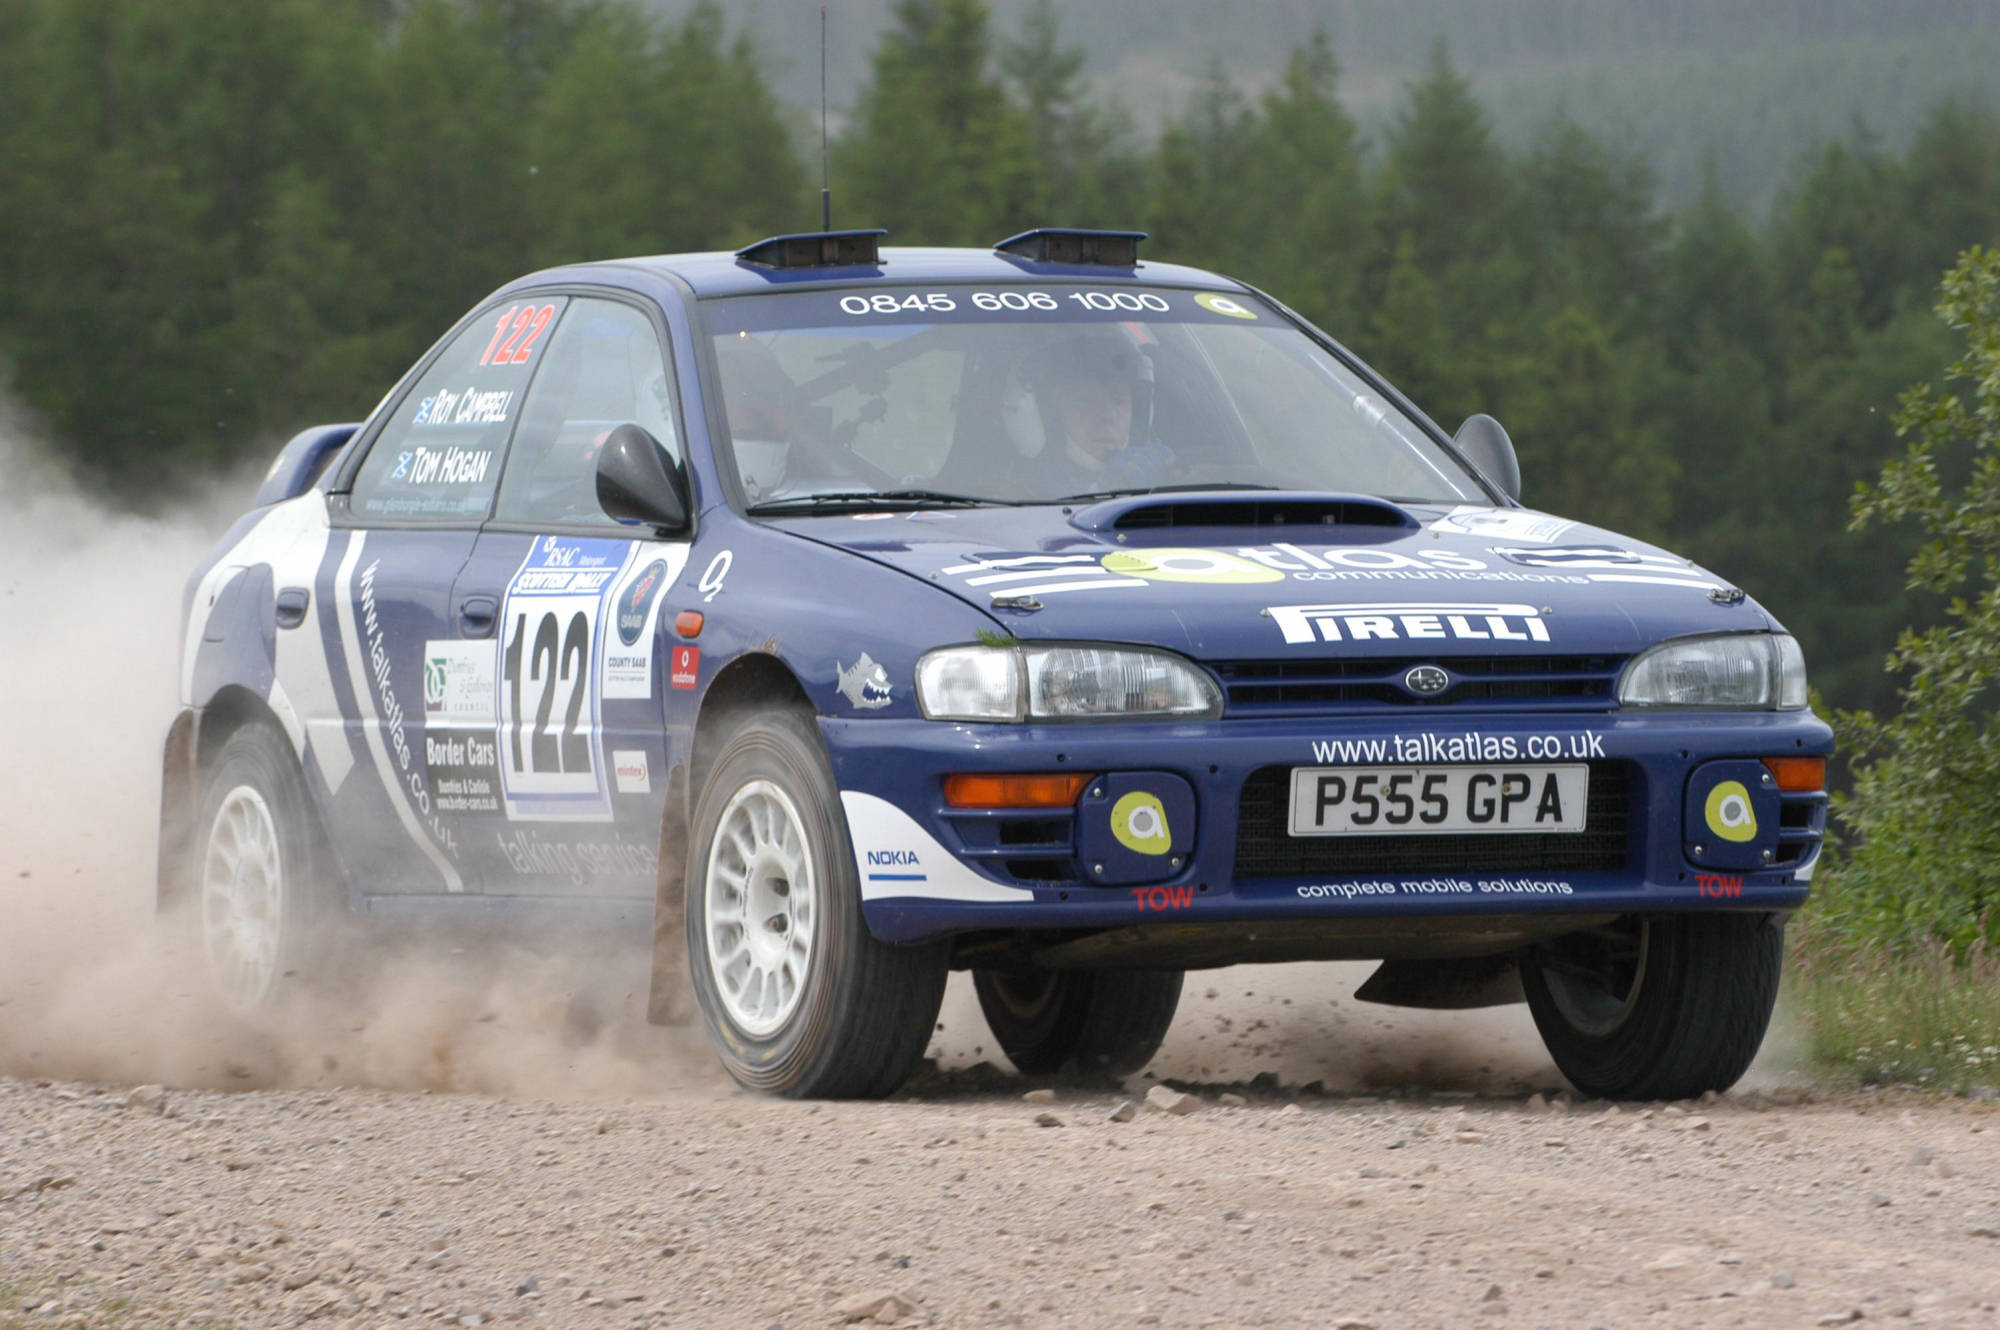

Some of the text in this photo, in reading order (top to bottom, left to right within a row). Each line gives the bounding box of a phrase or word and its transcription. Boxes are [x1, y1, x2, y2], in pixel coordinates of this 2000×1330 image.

[840, 292, 1170, 315] 0845 606 1000
[480, 303, 555, 366] 122
[428, 387, 513, 424] ROY CAMPBELL
[408, 447, 492, 483] TOM HOGAN
[1293, 568, 1590, 585] communications
[620, 613, 642, 629] SAAB
[1267, 603, 1551, 644] PIRELLI
[608, 656, 647, 669] COUNTY SAAB
[504, 610, 591, 774] 122
[360, 558, 459, 859] www.talkatlas.co.uk
[426, 736, 495, 766] Border Cars
[1311, 730, 1606, 763] www.talkatlas.co.uk
[1315, 773, 1563, 826] P555 GPA
[497, 829, 583, 886] talking
[867, 850, 919, 866] NOKIA
[1131, 885, 1195, 912] TOW
[1297, 878, 1574, 899] complete mobile solutions
[1695, 873, 1743, 898] TOW
